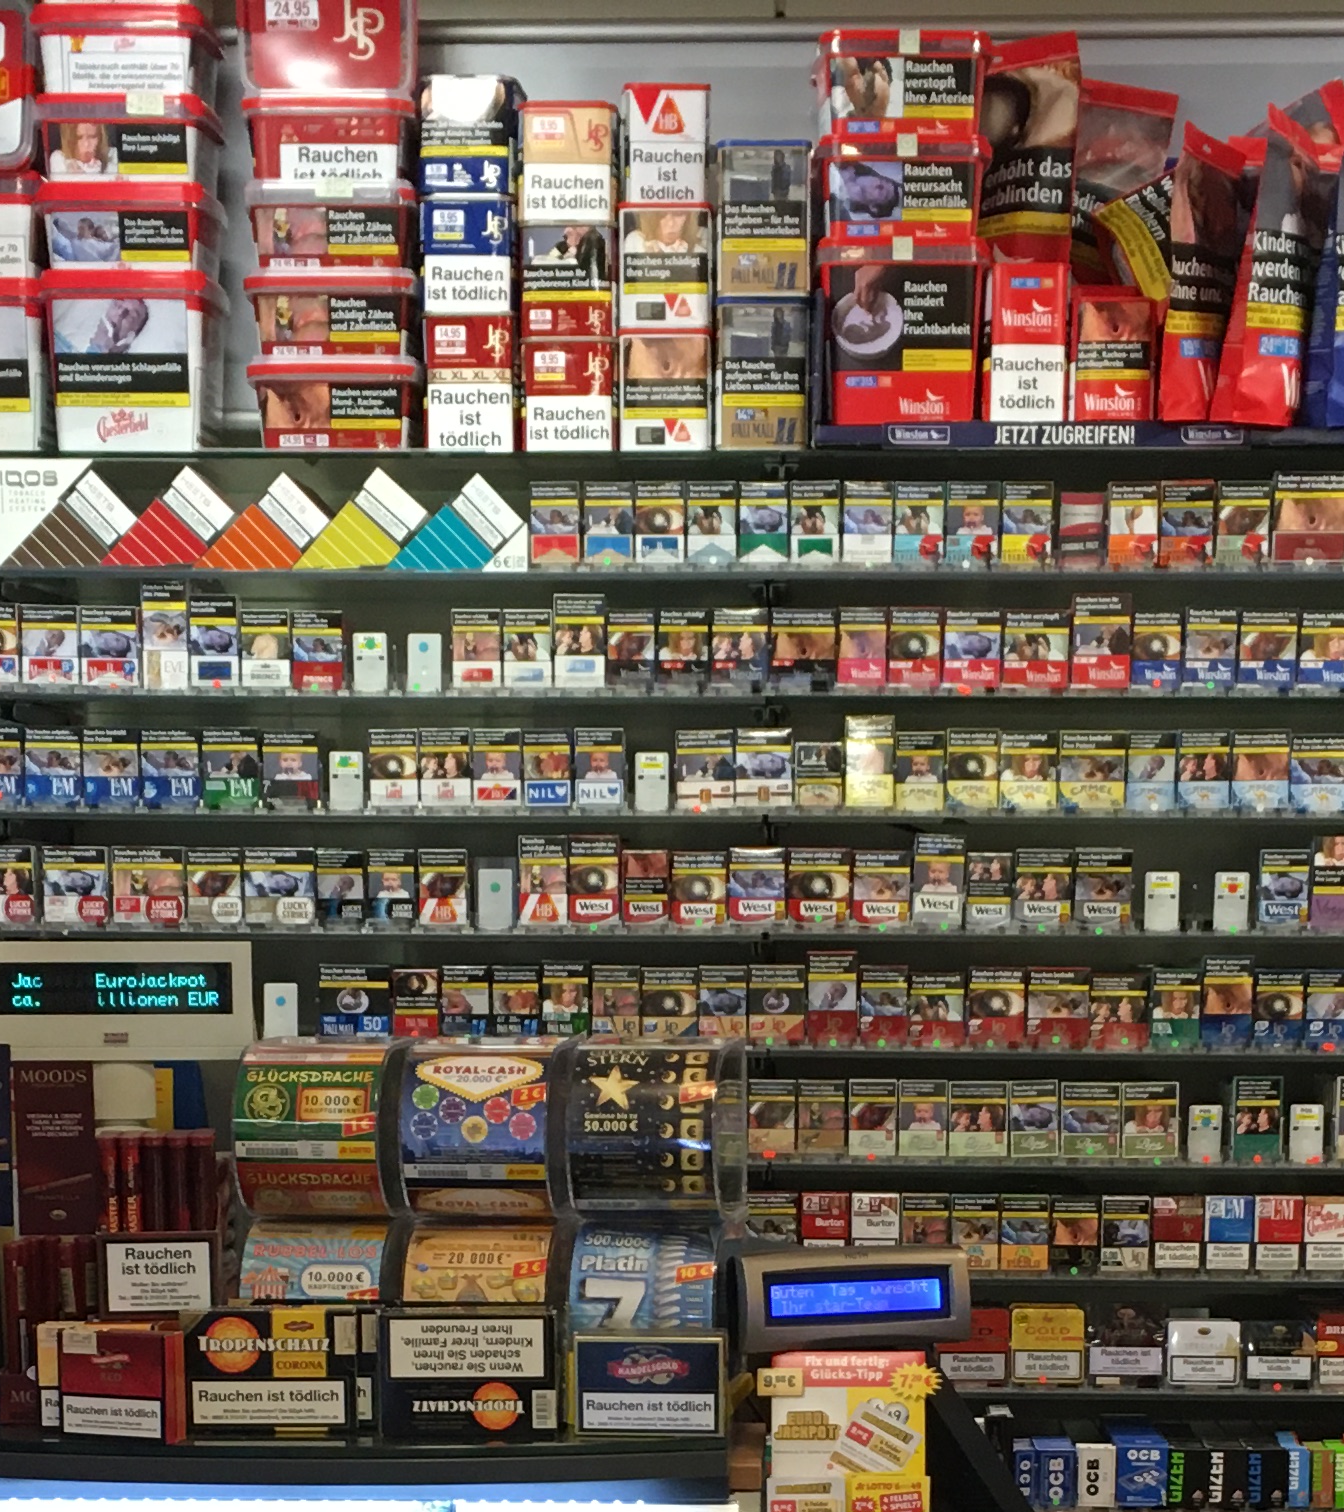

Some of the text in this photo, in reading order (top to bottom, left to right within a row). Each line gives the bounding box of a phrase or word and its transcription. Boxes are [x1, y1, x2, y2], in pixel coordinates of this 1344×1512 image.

[905, 61, 954, 74] Rauchen
[905, 75, 956, 91] verstopft
[905, 91, 974, 104] Ihre Arterien
[1001, 308, 1052, 328] Winston
[995, 425, 1135, 445] JETZT ZUGREIFEN!
[576, 900, 612, 912] West
[12, 973, 207, 989] Jac Eurojackpot
[12, 993, 41, 1007] ca.
[188, 992, 219, 1007] EUR
[586, 1053, 649, 1066] STERN
[247, 1067, 374, 1085] GLÜCKSDRACHE
[432, 1064, 528, 1076] ROYAL-CASH
[303, 1095, 363, 1107] 10.000 €
[584, 1120, 639, 1132] 50.000 €
[253, 1244, 377, 1259] RUBBEL-LOS
[580, 1254, 648, 1273] Platin
[198, 1336, 330, 1351] TROPENSCHATZ
[276, 1360, 324, 1371] CORONA
[806, 1356, 889, 1369] Fix und fertig:
[811, 1369, 883, 1381] Glücks-Tipp
[198, 1388, 339, 1404] Rauchen ist tödlich
[1086, 1460, 1100, 1496] OCB
